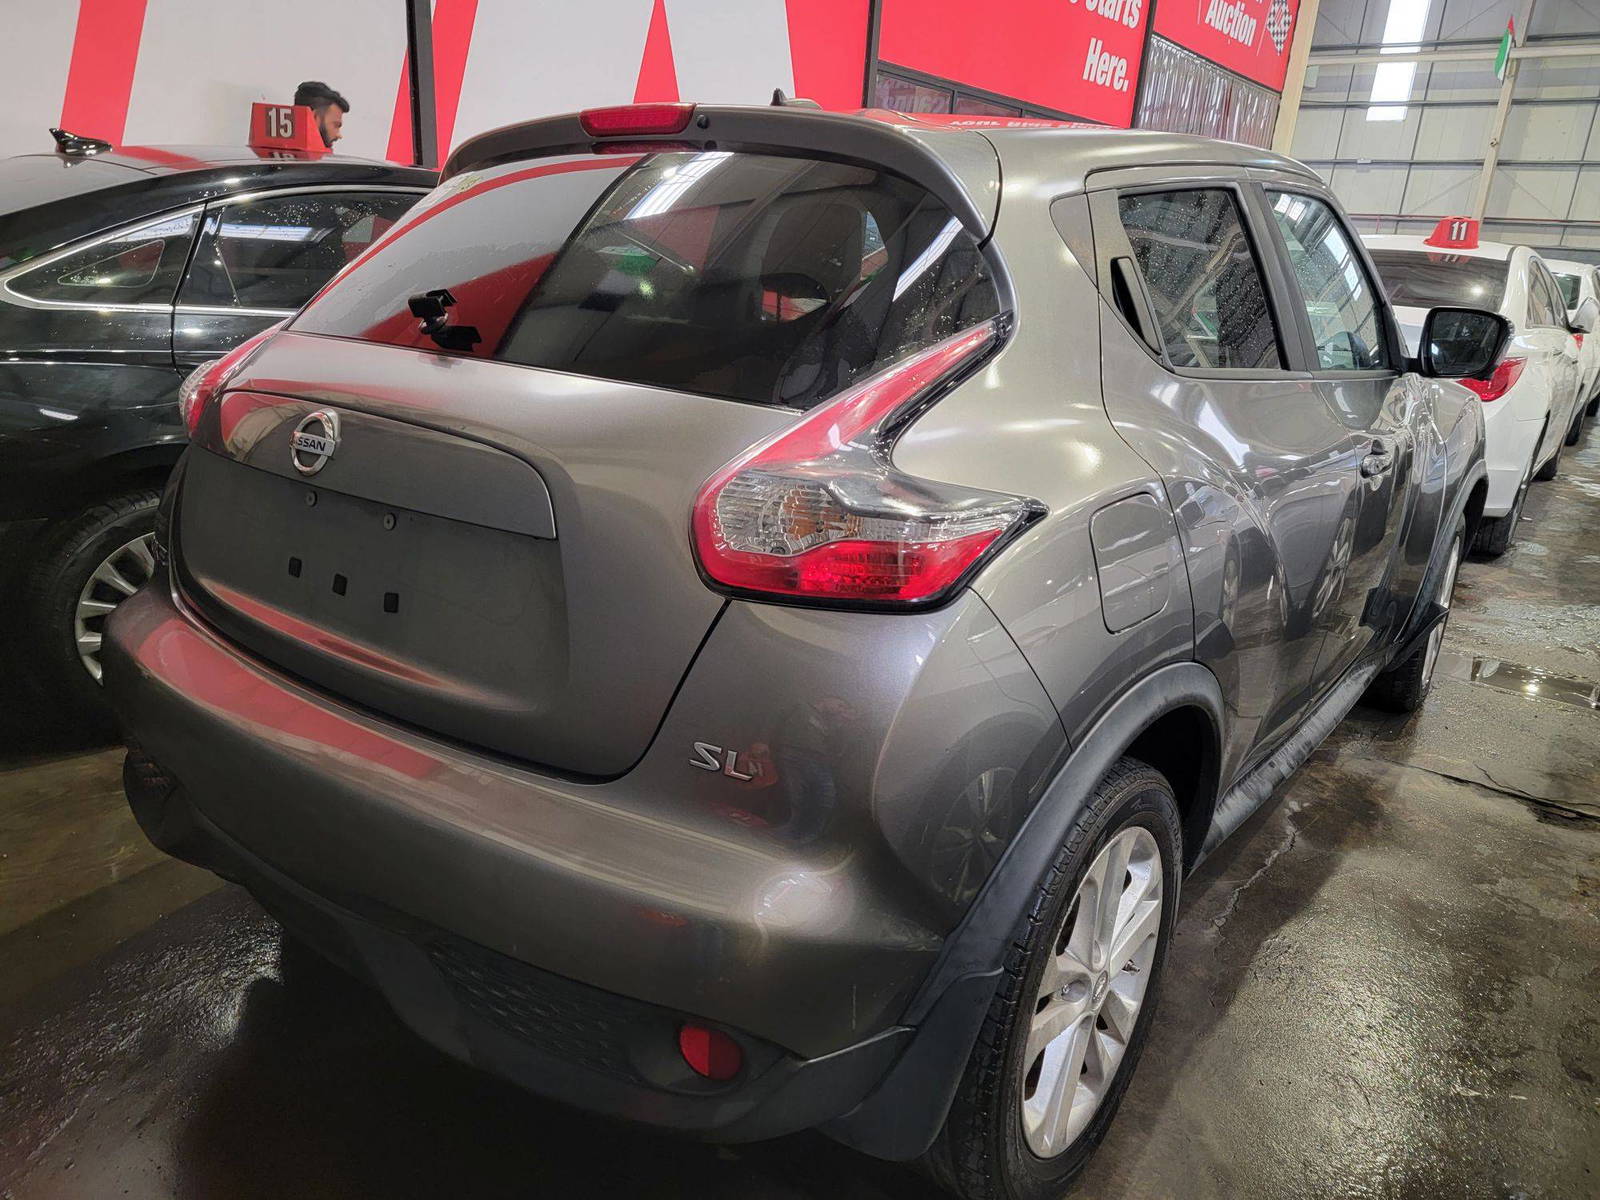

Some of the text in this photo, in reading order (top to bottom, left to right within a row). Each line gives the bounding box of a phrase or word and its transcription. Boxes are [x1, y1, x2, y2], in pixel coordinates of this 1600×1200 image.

[1085, 0, 1142, 29] arts
[1205, 0, 1257, 47] Auction
[1082, 37, 1128, 92] Here.
[268, 107, 292, 138] 15
[1452, 221, 1468, 240] 11
[294, 436, 326, 452] SSAN
[689, 741, 753, 781] SL
